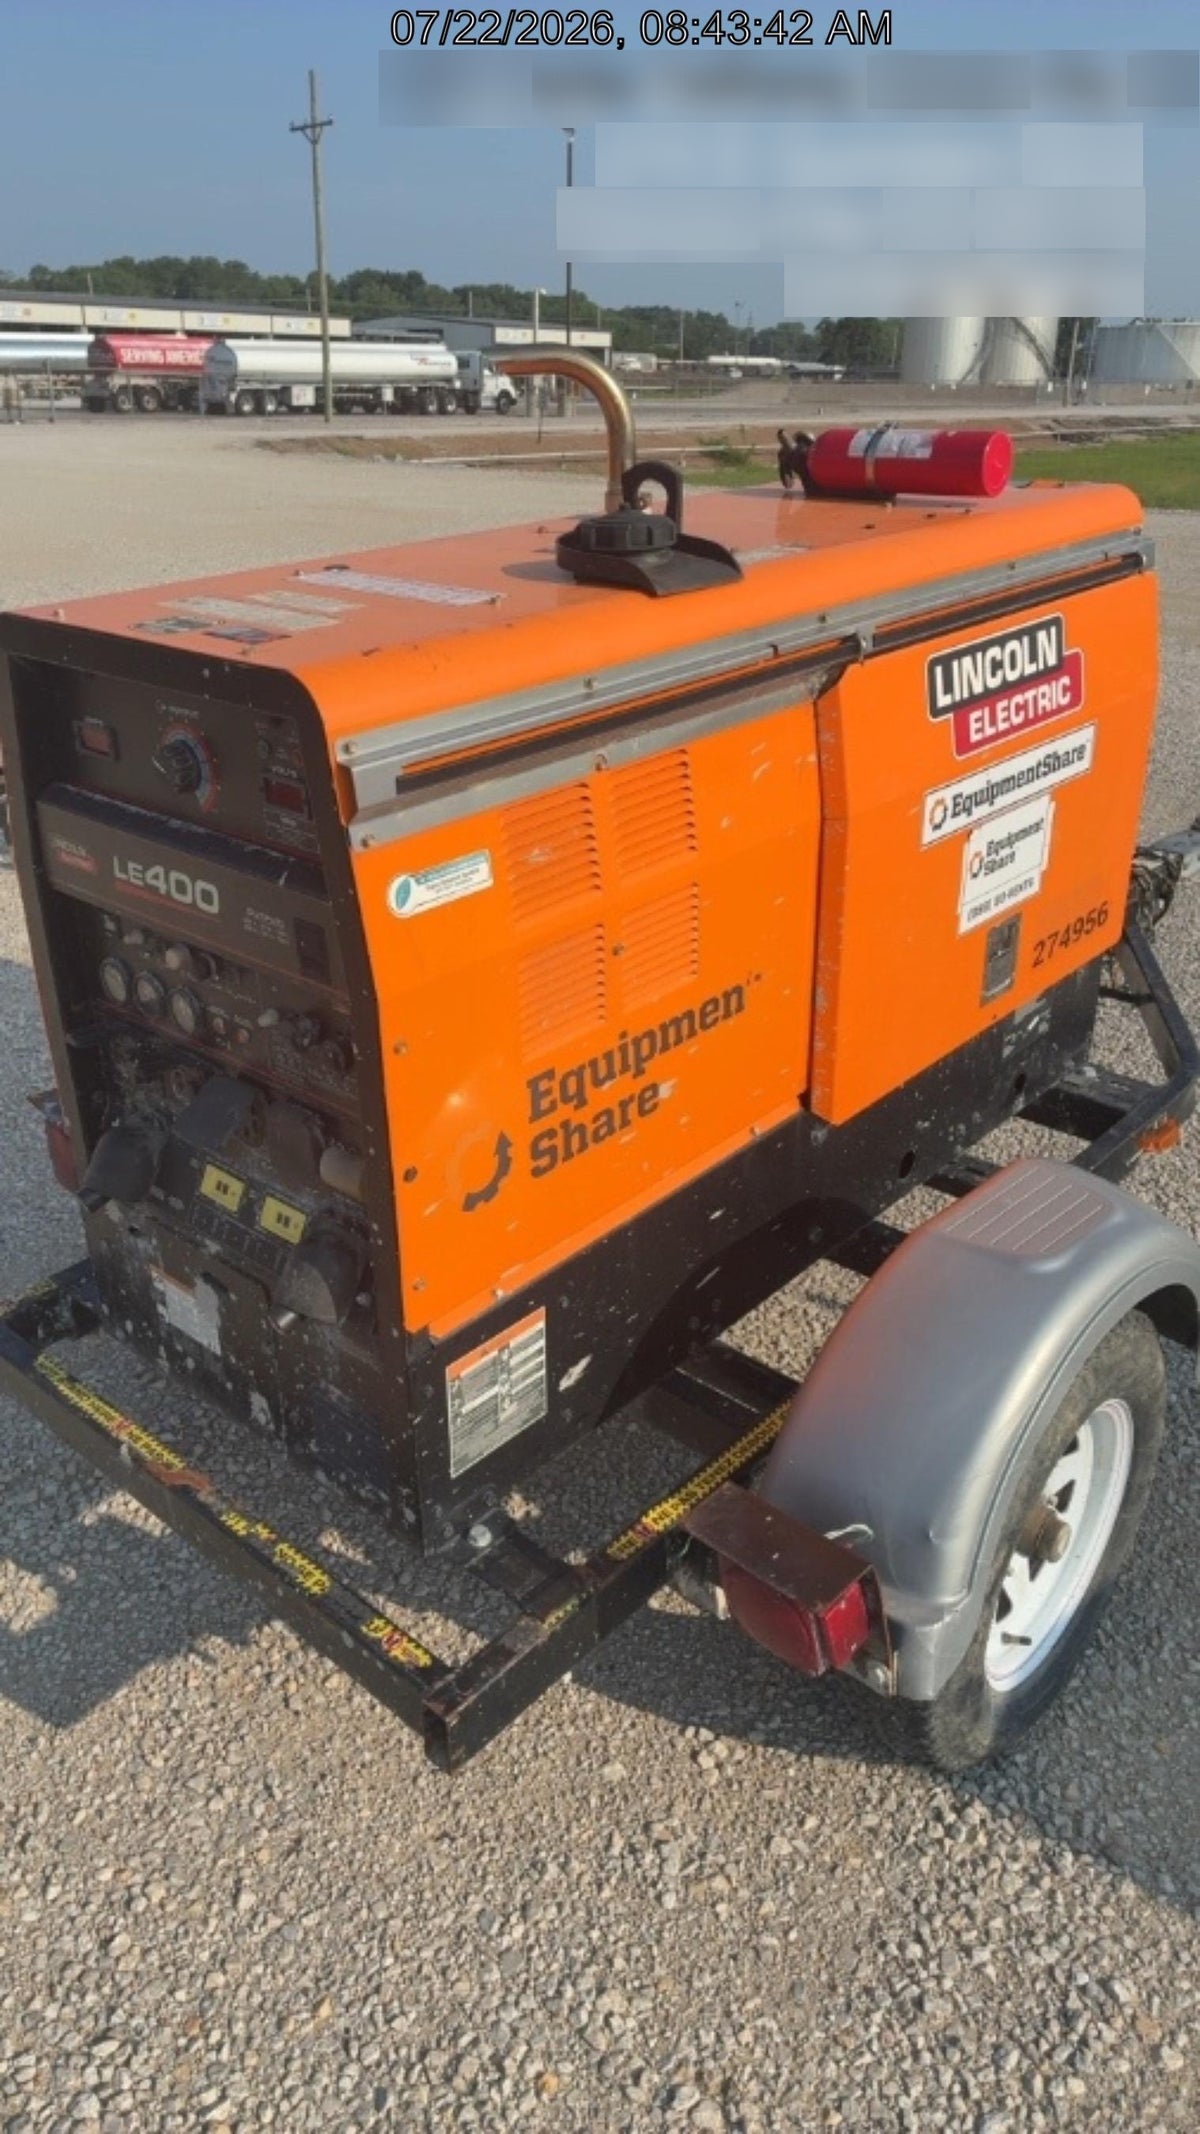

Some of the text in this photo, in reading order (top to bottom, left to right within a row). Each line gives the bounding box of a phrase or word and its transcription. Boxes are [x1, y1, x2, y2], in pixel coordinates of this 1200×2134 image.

[934, 626, 1057, 709] LINCOLN
[969, 675, 1072, 743] ELECTRIC
[950, 743, 1087, 818] EquipmentShare
[113, 856, 219, 914] LE400
[1032, 901, 1108, 968] 274956
[526, 976, 757, 1124] Equipmen
[530, 1082, 660, 1178] Share
